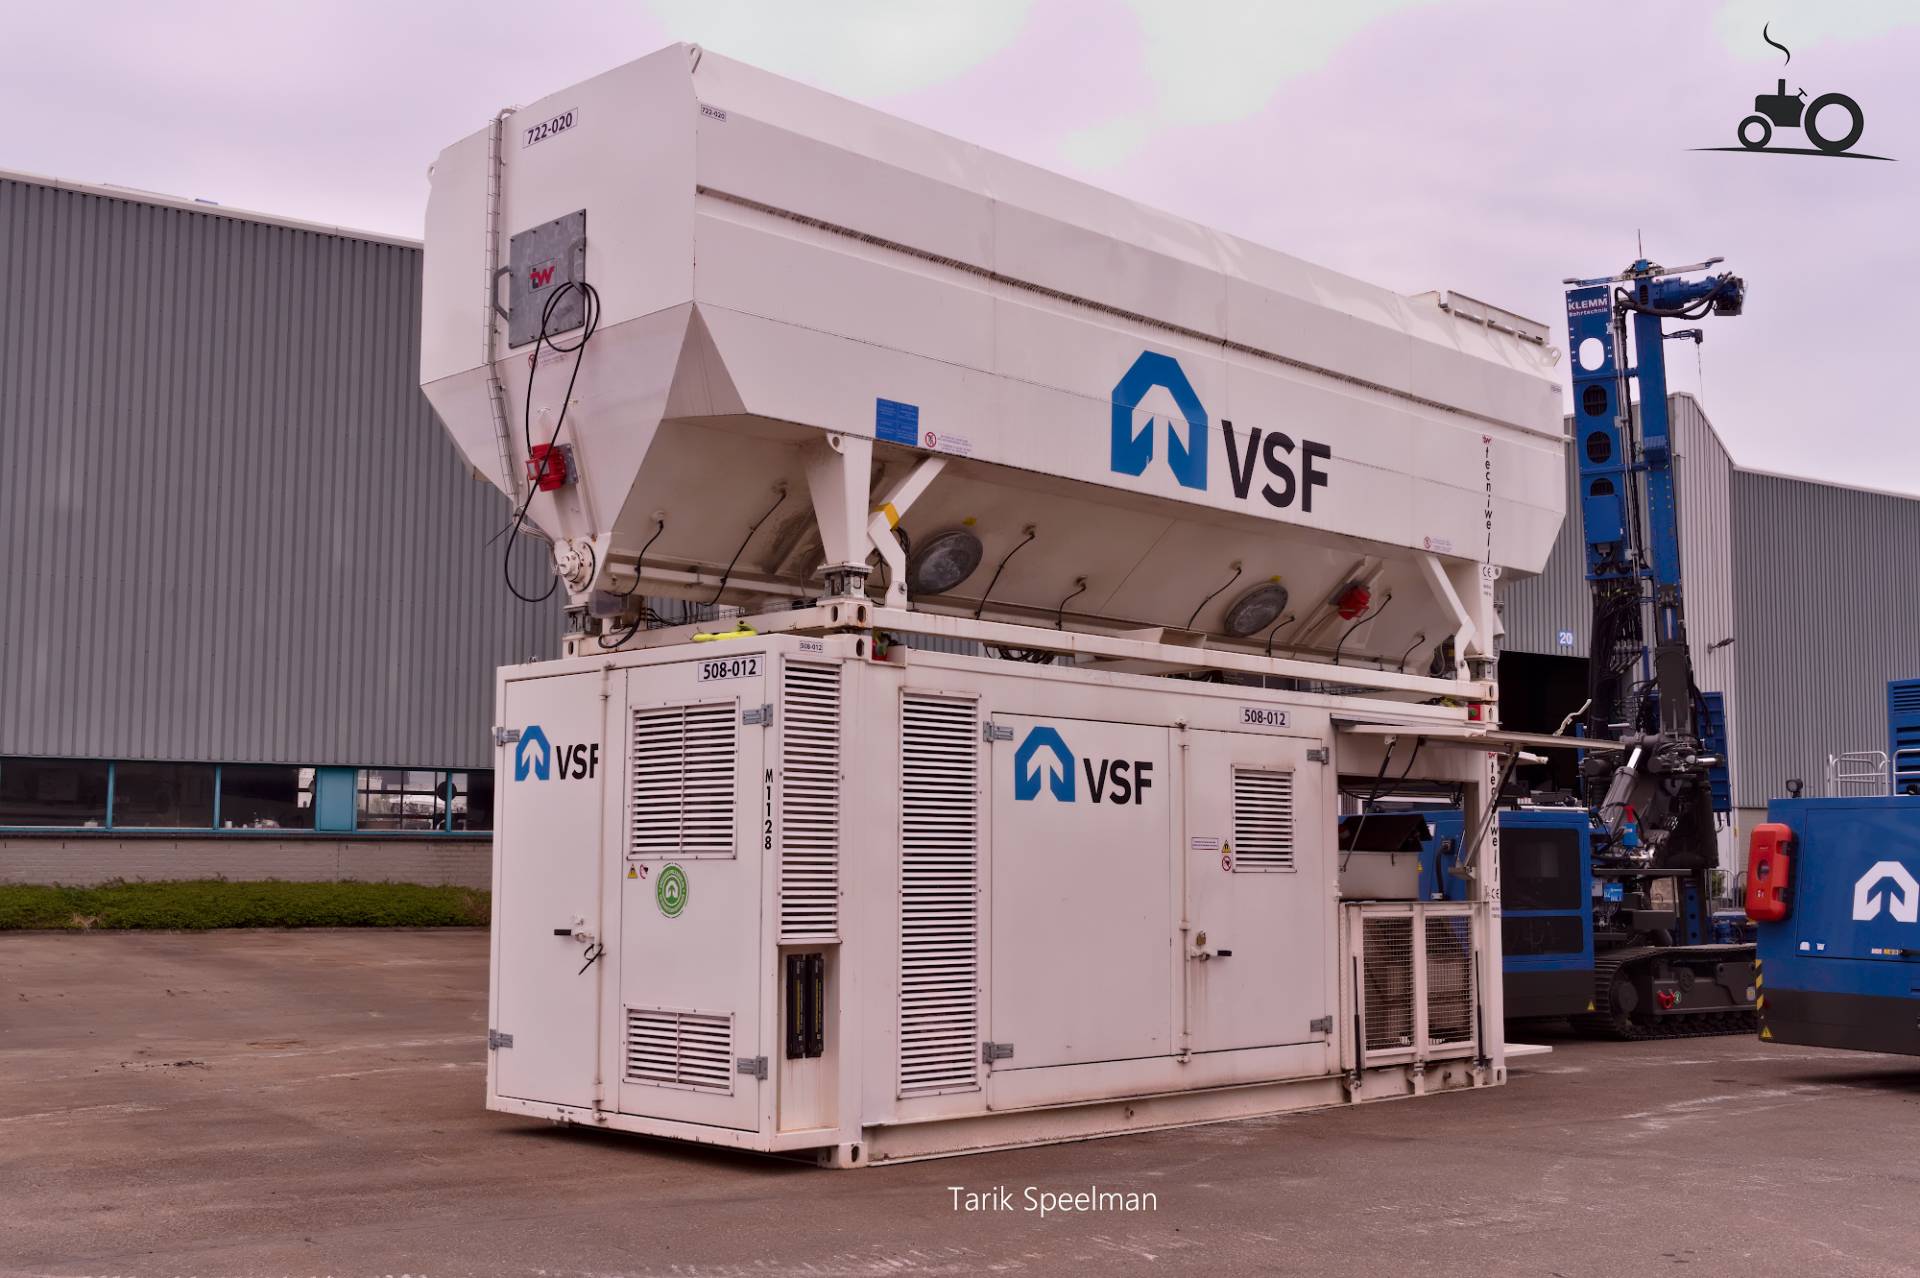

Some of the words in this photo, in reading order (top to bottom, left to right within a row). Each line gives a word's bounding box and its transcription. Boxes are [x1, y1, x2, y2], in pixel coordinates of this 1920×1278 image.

[527, 112, 573, 144] 722-020
[1568, 298, 1608, 310] KLEMM
[1221, 419, 1331, 513] VSF
[800, 642, 822, 651] 508-012
[1560, 631, 1573, 645] 20
[703, 659, 757, 680] 508-012
[1244, 709, 1286, 726] 508-012
[556, 743, 599, 780] VSF
[1083, 758, 1153, 805] VSF
[765, 768, 773, 850] M1128
